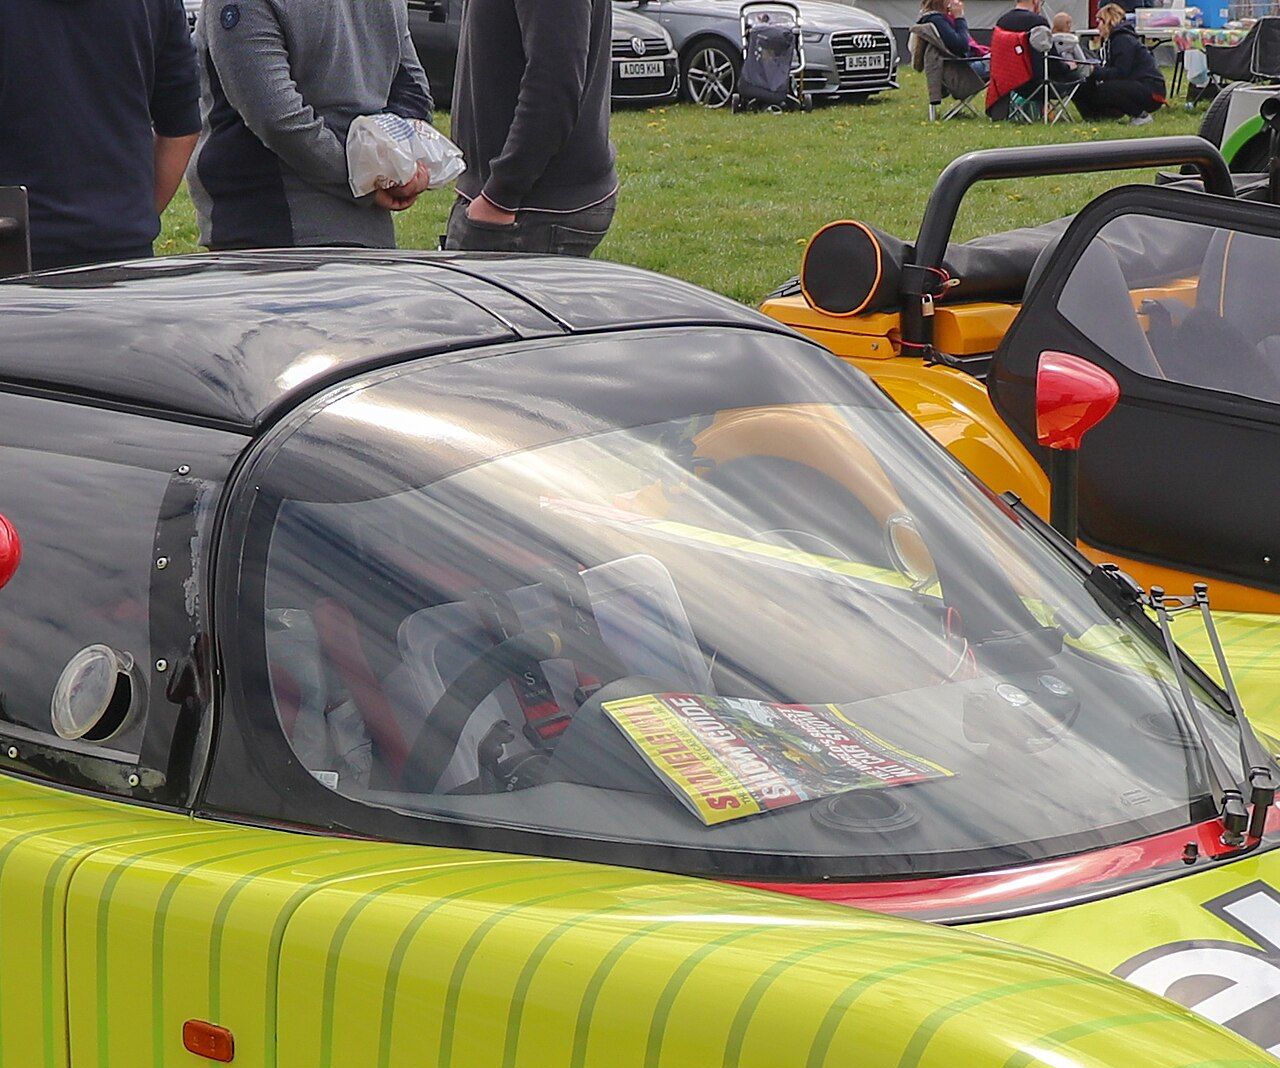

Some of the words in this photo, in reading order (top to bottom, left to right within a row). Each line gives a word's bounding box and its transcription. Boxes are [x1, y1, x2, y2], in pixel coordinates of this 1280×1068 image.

[670, 697, 738, 741] GUIDE
[790, 708, 851, 743] SHOW
[720, 745, 792, 800] SHOW
[841, 743, 888, 766] CAR
